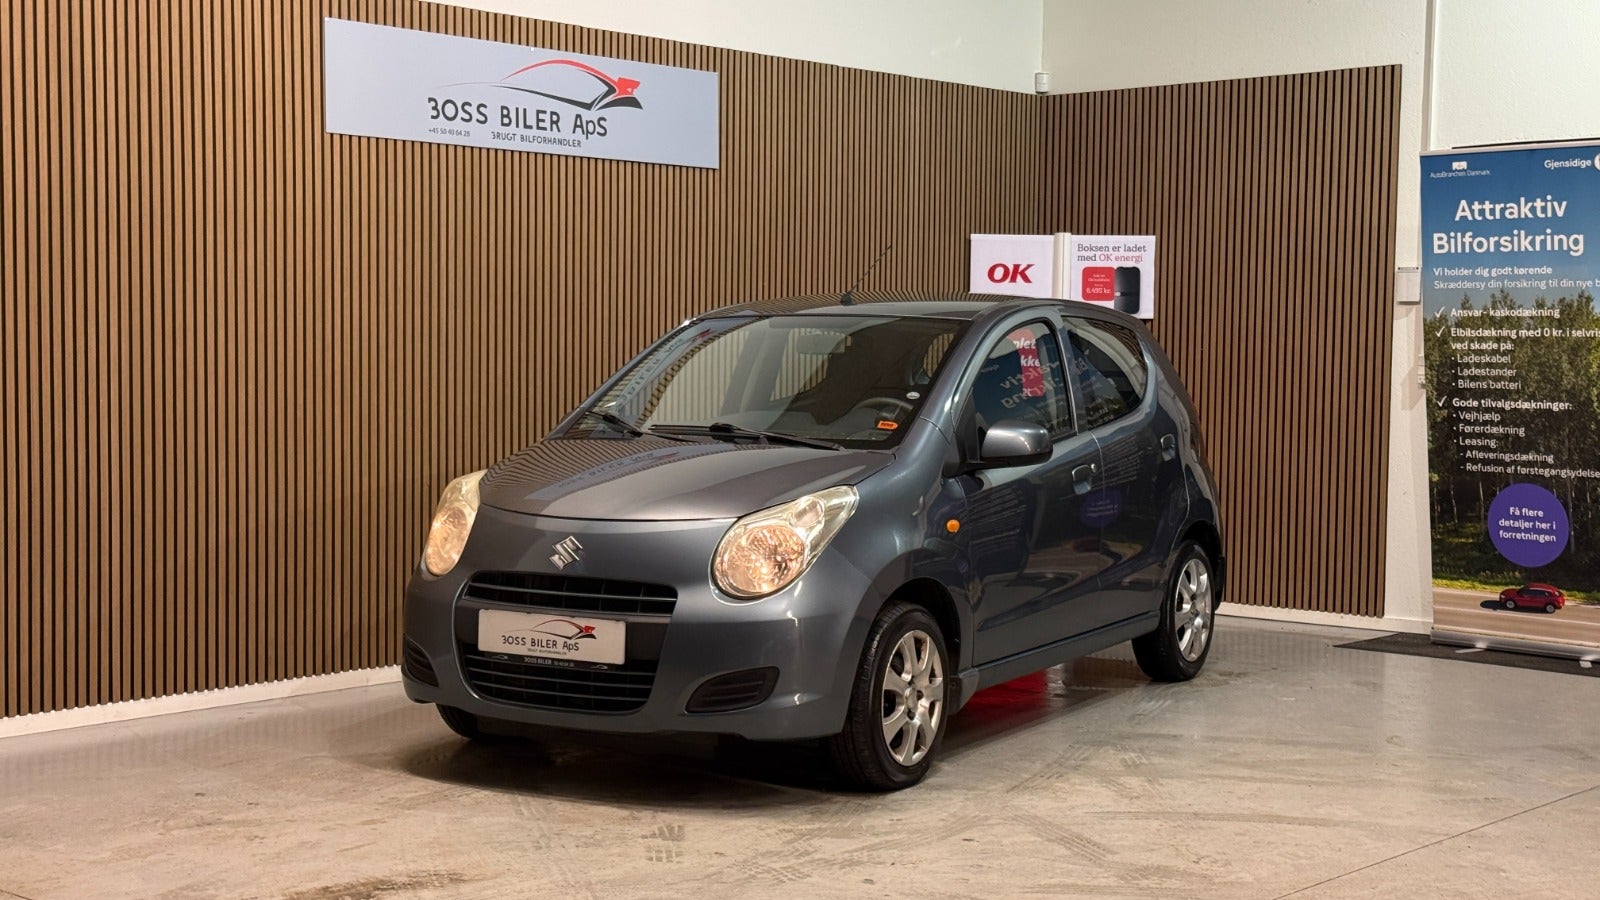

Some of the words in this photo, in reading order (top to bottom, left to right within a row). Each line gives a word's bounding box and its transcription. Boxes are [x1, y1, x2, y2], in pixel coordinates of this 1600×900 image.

[500, 105, 561, 133] BILER
[573, 113, 608, 140] ApS
[520, 134, 582, 148] BILFORHANDLER
[1544, 158, 1592, 170] Gjensidige
[1467, 169, 1491, 177] Danmark
[1454, 194, 1568, 221] Attraktiv
[1077, 244, 1110, 252] Boksen
[1124, 244, 1147, 252] ladet
[1432, 228, 1584, 256] Bilforsikring
[1077, 254, 1097, 262] med
[1099, 254, 1112, 262] OK
[1114, 254, 1143, 264] energi
[987, 263, 1035, 284] OK
[1433, 267, 1443, 276] Vi
[1444, 267, 1473, 276] holder
[1474, 266, 1490, 277] dig
[1491, 266, 1512, 277] godt
[1514, 266, 1552, 275] kørende
[1434, 280, 1486, 290] Skræddersy
[1488, 279, 1502, 288] din
[1504, 279, 1546, 290] forsikring
[1548, 278, 1558, 288] til
[1560, 278, 1574, 288] din
[1576, 280, 1593, 290] nye
[1450, 308, 1487, 317] Ansvar-
[1489, 307, 1560, 318] kaskodækning
[1450, 328, 1517, 340] Elbilsdækning
[1518, 328, 1542, 338] med
[1543, 328, 1550, 337] 0
[1552, 328, 1565, 337] kr.
[1566, 328, 1570, 337] i
[1450, 341, 1468, 350] ved
[1470, 341, 1498, 350] skade
[1500, 341, 1514, 352] på:
[1457, 354, 1511, 364] Ladeskabel
[1457, 366, 1517, 376] Ladestander
[1458, 379, 1488, 389] Bilens
[1490, 380, 1522, 390] batteri
[1452, 398, 1479, 408] Gode
[1481, 398, 1572, 410] tilvalgsdækninger:
[1458, 411, 1500, 422] Vejhjælp
[1459, 424, 1526, 437] Førerdækning
[1460, 436, 1499, 448] Leasing:
[1465, 450, 1554, 464] Afleveringsdækning
[1466, 462, 1504, 474] Refusion
[1506, 465, 1516, 474] af
[1517, 465, 1600, 479] førstegangsydelse
[1510, 506, 1520, 516] Få
[1522, 507, 1544, 518] flere
[1498, 518, 1534, 530] detaljer
[1536, 520, 1551, 530] her
[1552, 520, 1556, 530] i
[1499, 530, 1556, 544] forretningen
[531, 638, 557, 649] BILER
[562, 640, 580, 652] ApS
